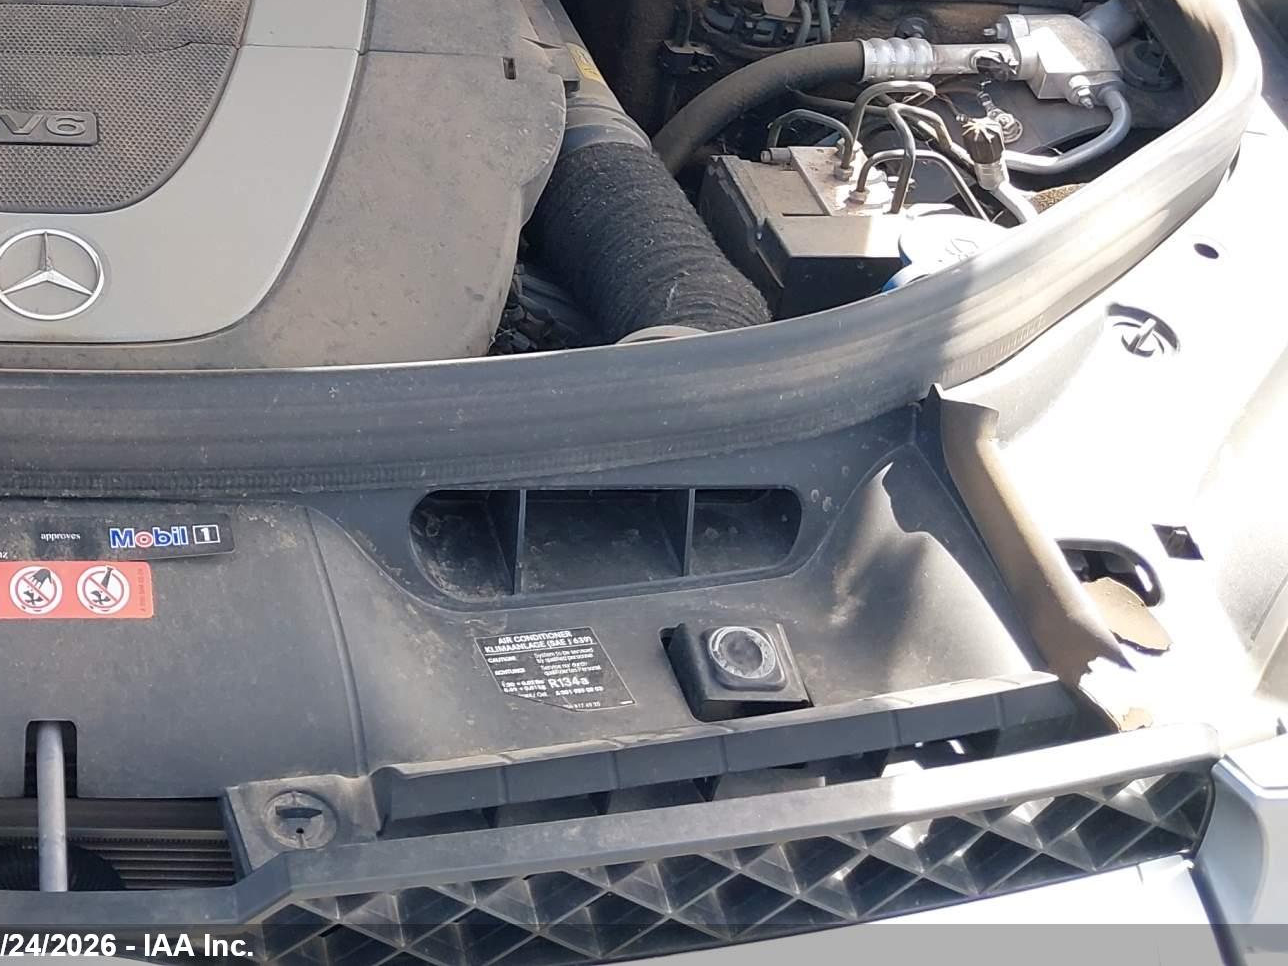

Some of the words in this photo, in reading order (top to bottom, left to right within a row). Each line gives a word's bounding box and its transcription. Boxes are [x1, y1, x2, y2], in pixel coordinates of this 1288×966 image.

[40, 533, 81, 542] approves
[109, 525, 188, 549] Mobil
[498, 636, 513, 645] AIR
[514, 631, 572, 643] CONDITIONER
[484, 640, 546, 653] KLIMAANLAGE
[547, 676, 590, 689] R134a
